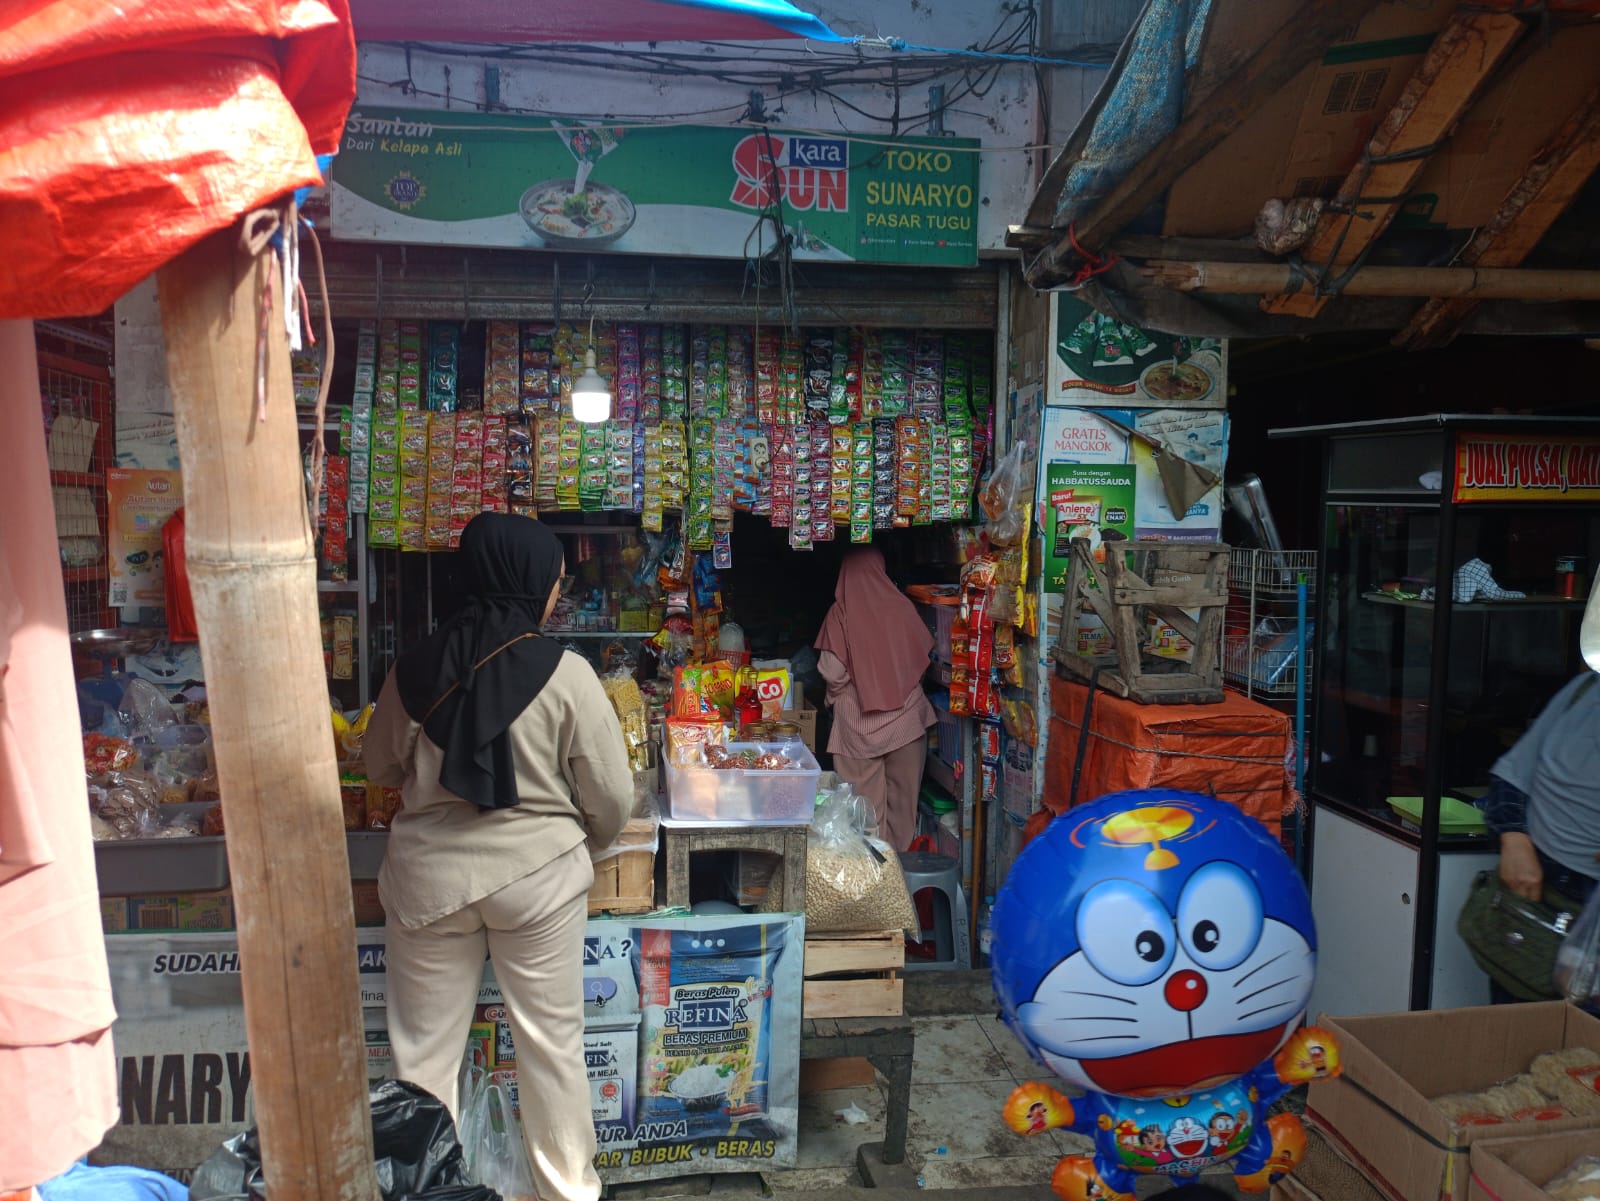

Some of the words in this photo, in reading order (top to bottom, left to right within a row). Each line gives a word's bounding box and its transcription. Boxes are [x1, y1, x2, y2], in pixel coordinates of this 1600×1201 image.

[347, 113, 433, 137] Santan
[346, 137, 374, 151] Dari
[380, 139, 428, 157] Kelapa
[435, 142, 462, 156] Asli
[794, 139, 841, 165] kara
[885, 150, 951, 172] TOKO
[729, 135, 848, 212] SUN
[866, 181, 973, 208] SUNARYO
[867, 212, 921, 228] PASAR
[927, 215, 971, 230] TUGU
[1062, 427, 1107, 440] GRATIS
[1054, 440, 1112, 452] MANGKOK
[1465, 442, 1505, 486] JUAL
[1051, 478, 1131, 486] HABBATUSSAUDA
[1058, 503, 1091, 513] Anlene
[153, 953, 241, 973] SUDAH
[676, 989, 707, 1000] Beras
[708, 986, 740, 998] Pulen
[665, 1004, 746, 1026] REFINA
[664, 1034, 700, 1045] BERAS
[701, 1029, 747, 1044] PREMIUM
[585, 1054, 617, 1065] FINA
[598, 1069, 619, 1078] MEJA
[118, 1052, 251, 1126] NARY
[633, 1121, 687, 1141] ANDA
[593, 1151, 624, 1168] AR
[630, 1144, 693, 1166] BUBUK
[716, 1140, 776, 1158] BERAS
